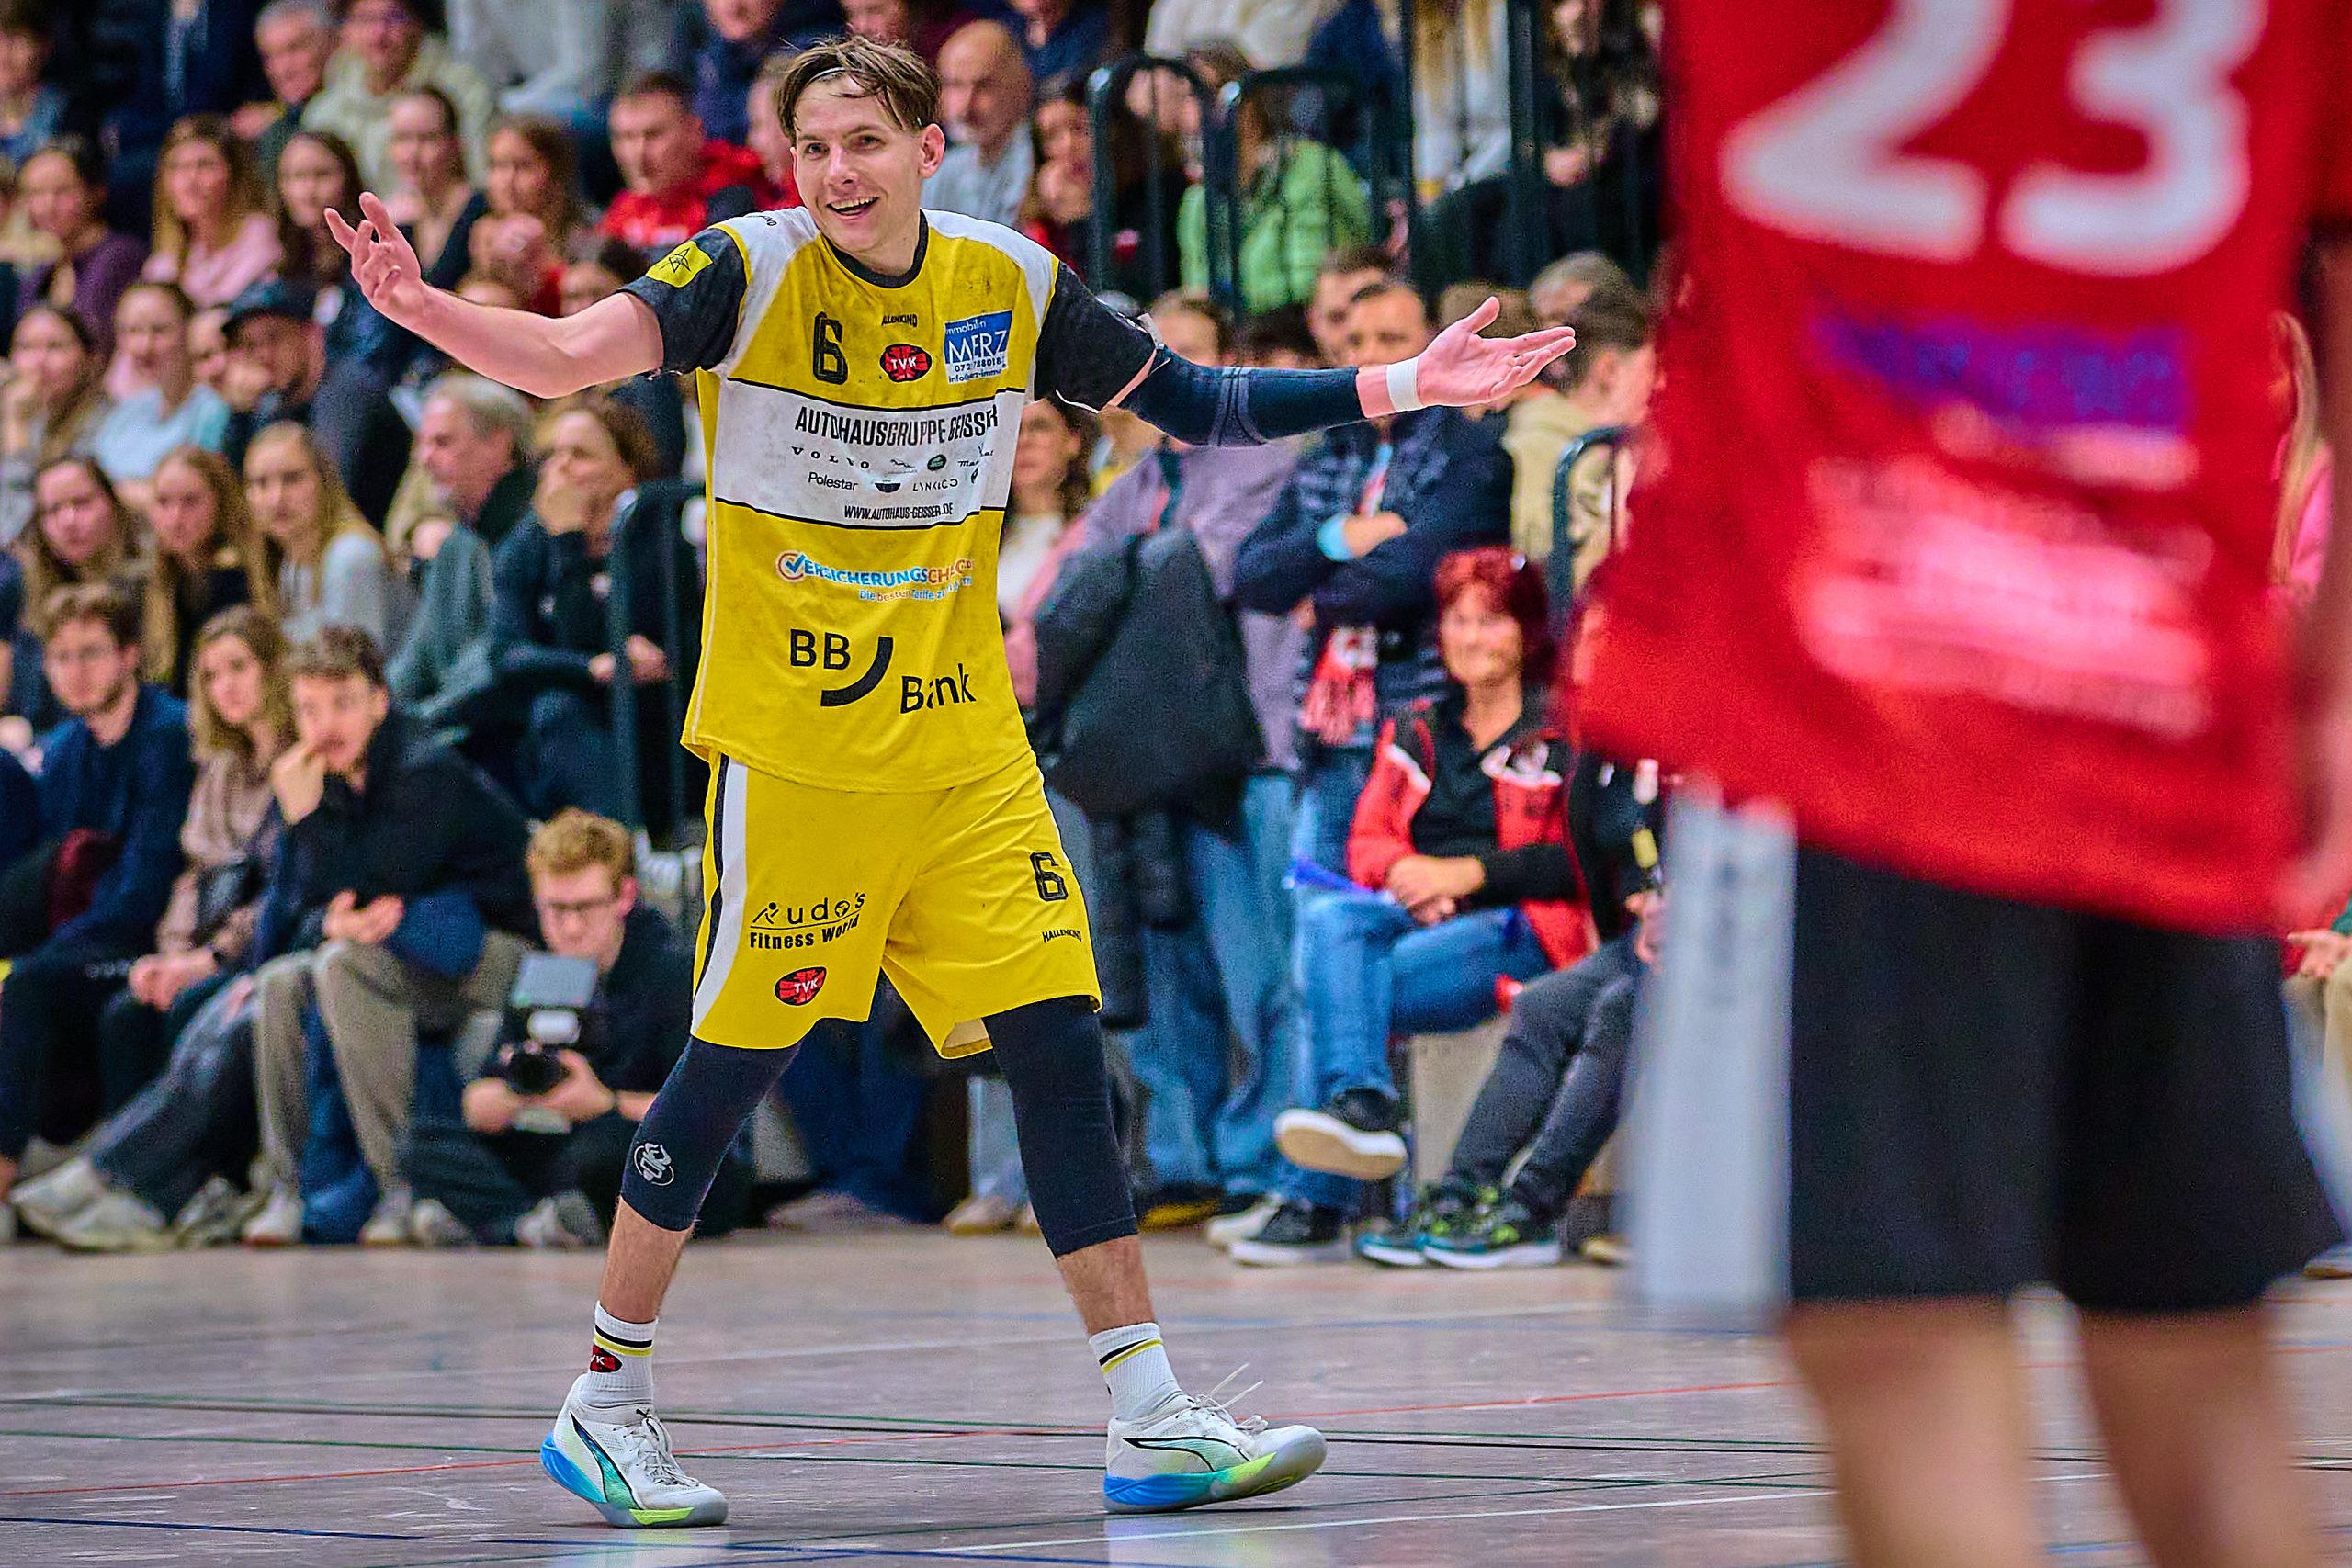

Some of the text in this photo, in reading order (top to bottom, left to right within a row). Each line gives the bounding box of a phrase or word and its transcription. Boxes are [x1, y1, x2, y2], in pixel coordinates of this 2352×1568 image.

[1716, 0, 2269, 277] 23
[813, 311, 848, 385] 6
[890, 356, 917, 370] TVK
[948, 329, 1007, 364] MERZ
[795, 407, 945, 446] AUTOHAUSGRUPPE
[808, 471, 858, 491] Polestar
[844, 502, 954, 520] WWW.AUTOHAUS-GEISSER.DE
[860, 590, 876, 600] Die
[790, 628, 851, 671] BB
[1029, 852, 1069, 902] 6
[750, 913, 860, 950] Fitness World
[794, 978, 818, 994] TVK
